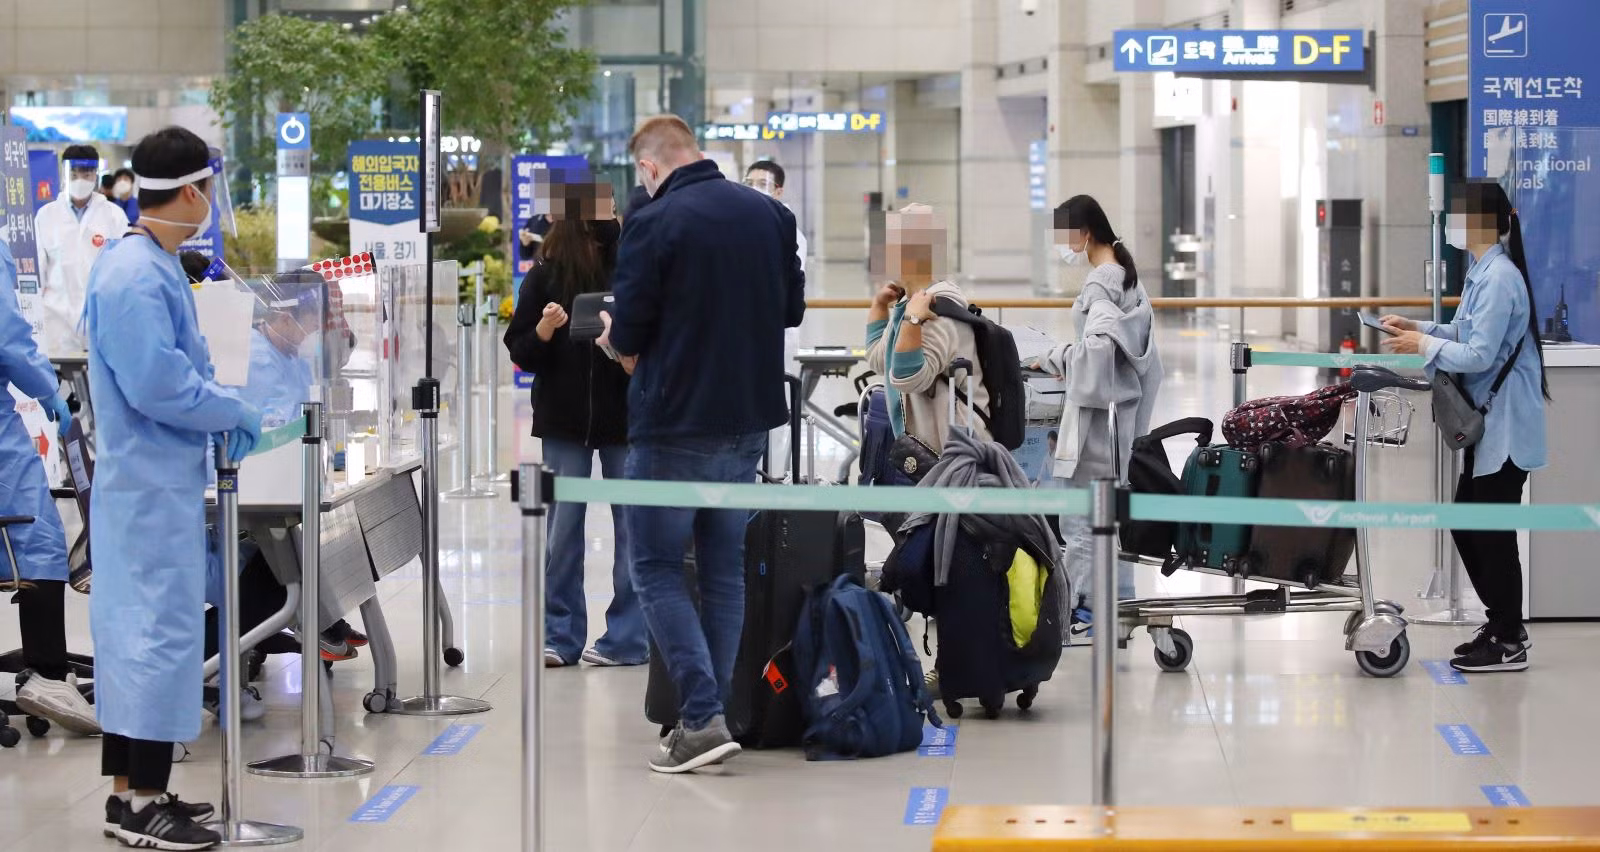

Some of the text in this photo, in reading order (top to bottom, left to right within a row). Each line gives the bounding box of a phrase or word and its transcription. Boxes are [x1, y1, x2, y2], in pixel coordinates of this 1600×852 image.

[1293, 35, 1350, 65] D-F
[1483, 76, 1583, 99] 국제선도착
[1483, 109, 1559, 126] 国際線到着
[5, 139, 28, 169] 외국인
[352, 155, 419, 173] 해외입국자
[359, 174, 414, 192] 전용버스
[359, 192, 415, 211] 대기장소
[394, 241, 417, 260] 경기
[1391, 512, 1437, 526] Airport
